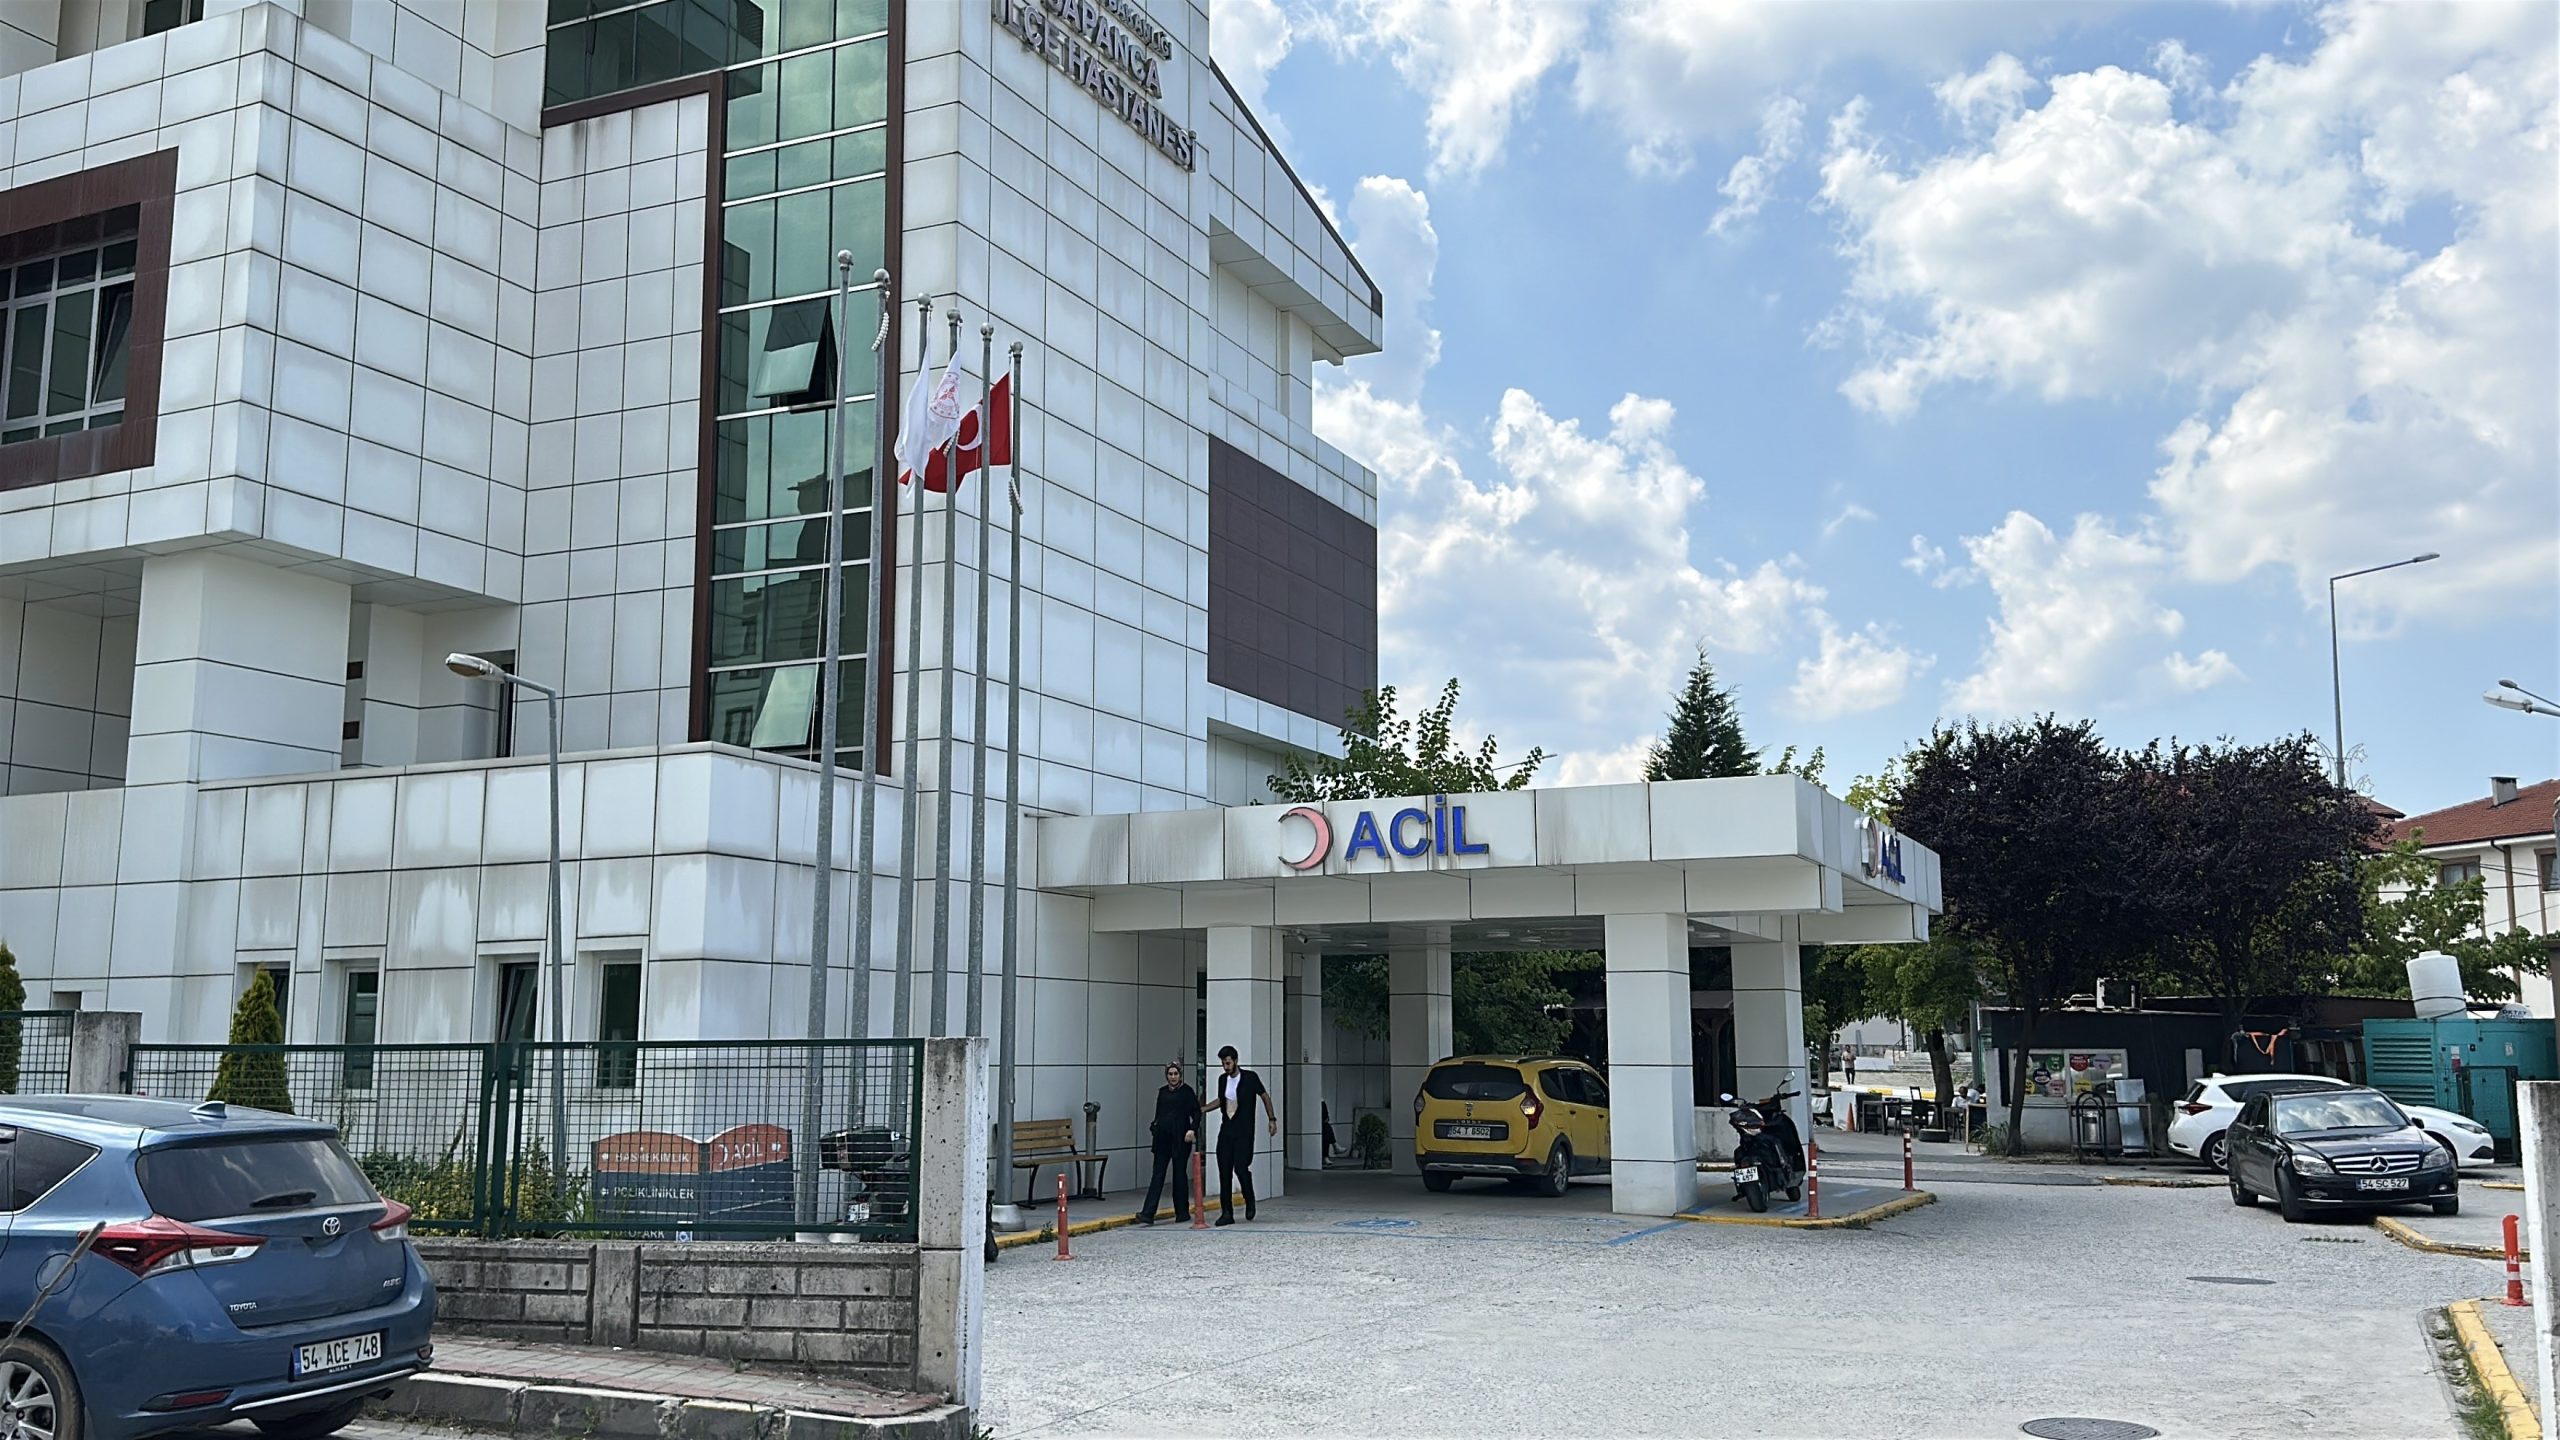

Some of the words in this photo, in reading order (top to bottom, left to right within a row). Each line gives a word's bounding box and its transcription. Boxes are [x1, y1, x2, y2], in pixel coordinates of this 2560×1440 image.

[1068, 40, 1197, 173] HASTANESİ
[1344, 793, 1489, 861] ACİL
[229, 1302, 257, 1312] TOYOTA
[302, 1346, 319, 1371] 54
[326, 1341, 350, 1367] ACE
[355, 1335, 378, 1361] 748
